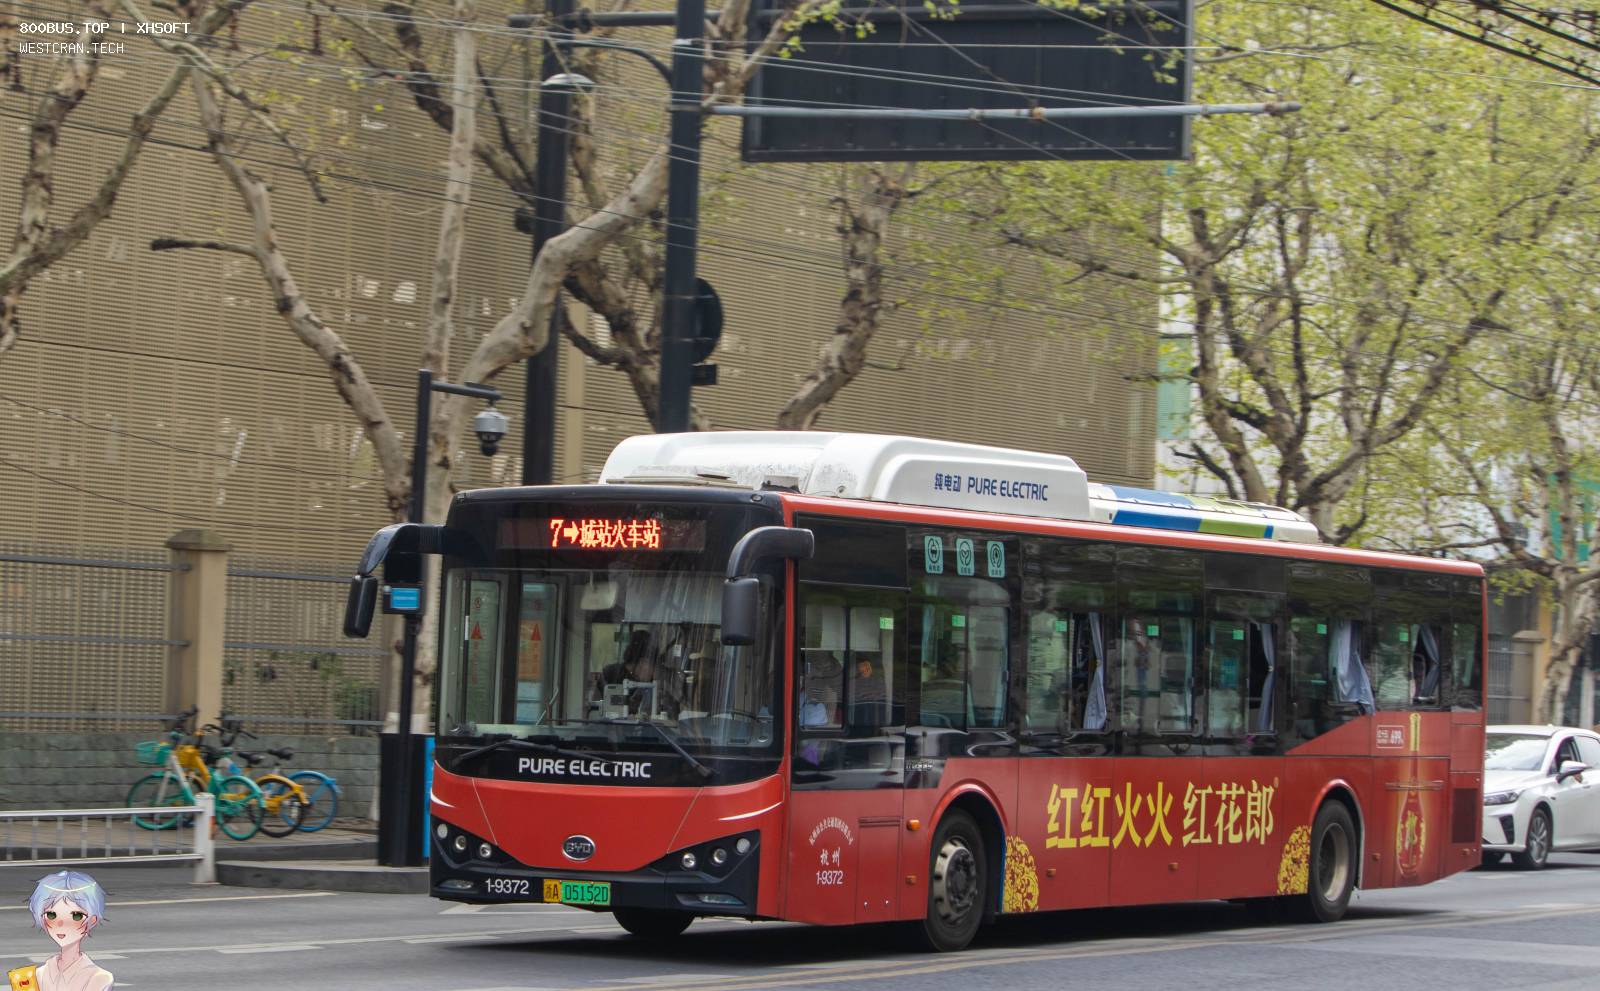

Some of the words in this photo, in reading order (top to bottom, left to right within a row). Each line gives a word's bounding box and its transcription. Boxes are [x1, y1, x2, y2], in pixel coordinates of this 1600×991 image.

[967, 476, 998, 496] PURE
[1000, 480, 1048, 501] ELECTRIC
[550, 519, 563, 547] 7
[579, 519, 661, 548] 城站火车站
[518, 757, 565, 775] PURE
[569, 759, 652, 778] ELECTRIC
[1045, 781, 1174, 849] 红红火火
[1182, 779, 1275, 848] 红花郎
[566, 842, 591, 853] BYD
[485, 877, 530, 895] 1-9372
[815, 870, 844, 885] 1-9372
